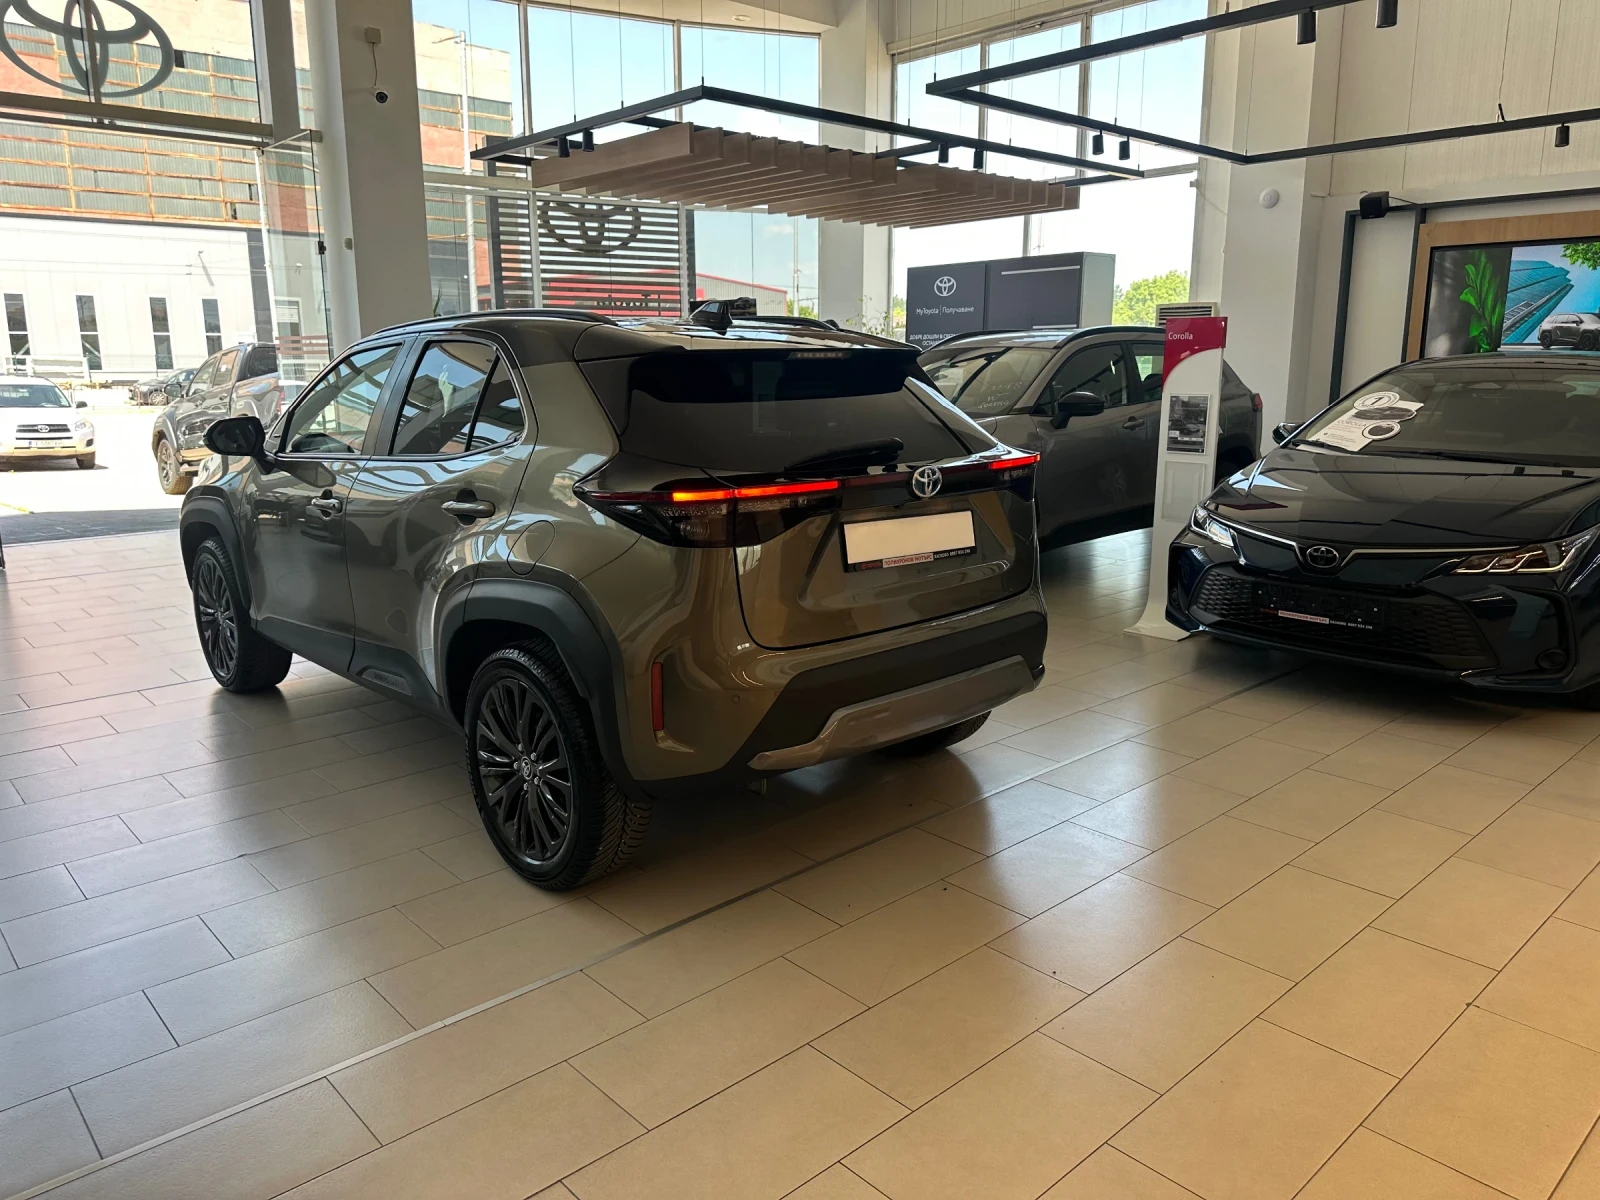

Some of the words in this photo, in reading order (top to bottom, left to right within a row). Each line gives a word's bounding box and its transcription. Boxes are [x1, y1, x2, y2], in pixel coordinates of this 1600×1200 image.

[916, 307, 939, 315] MyToyota
[942, 306, 975, 315] Получаване
[1168, 331, 1193, 340] Corolla
[884, 556, 914, 566] ПОЛИХРОНОВ
[914, 554, 932, 562] МОТЪРС
